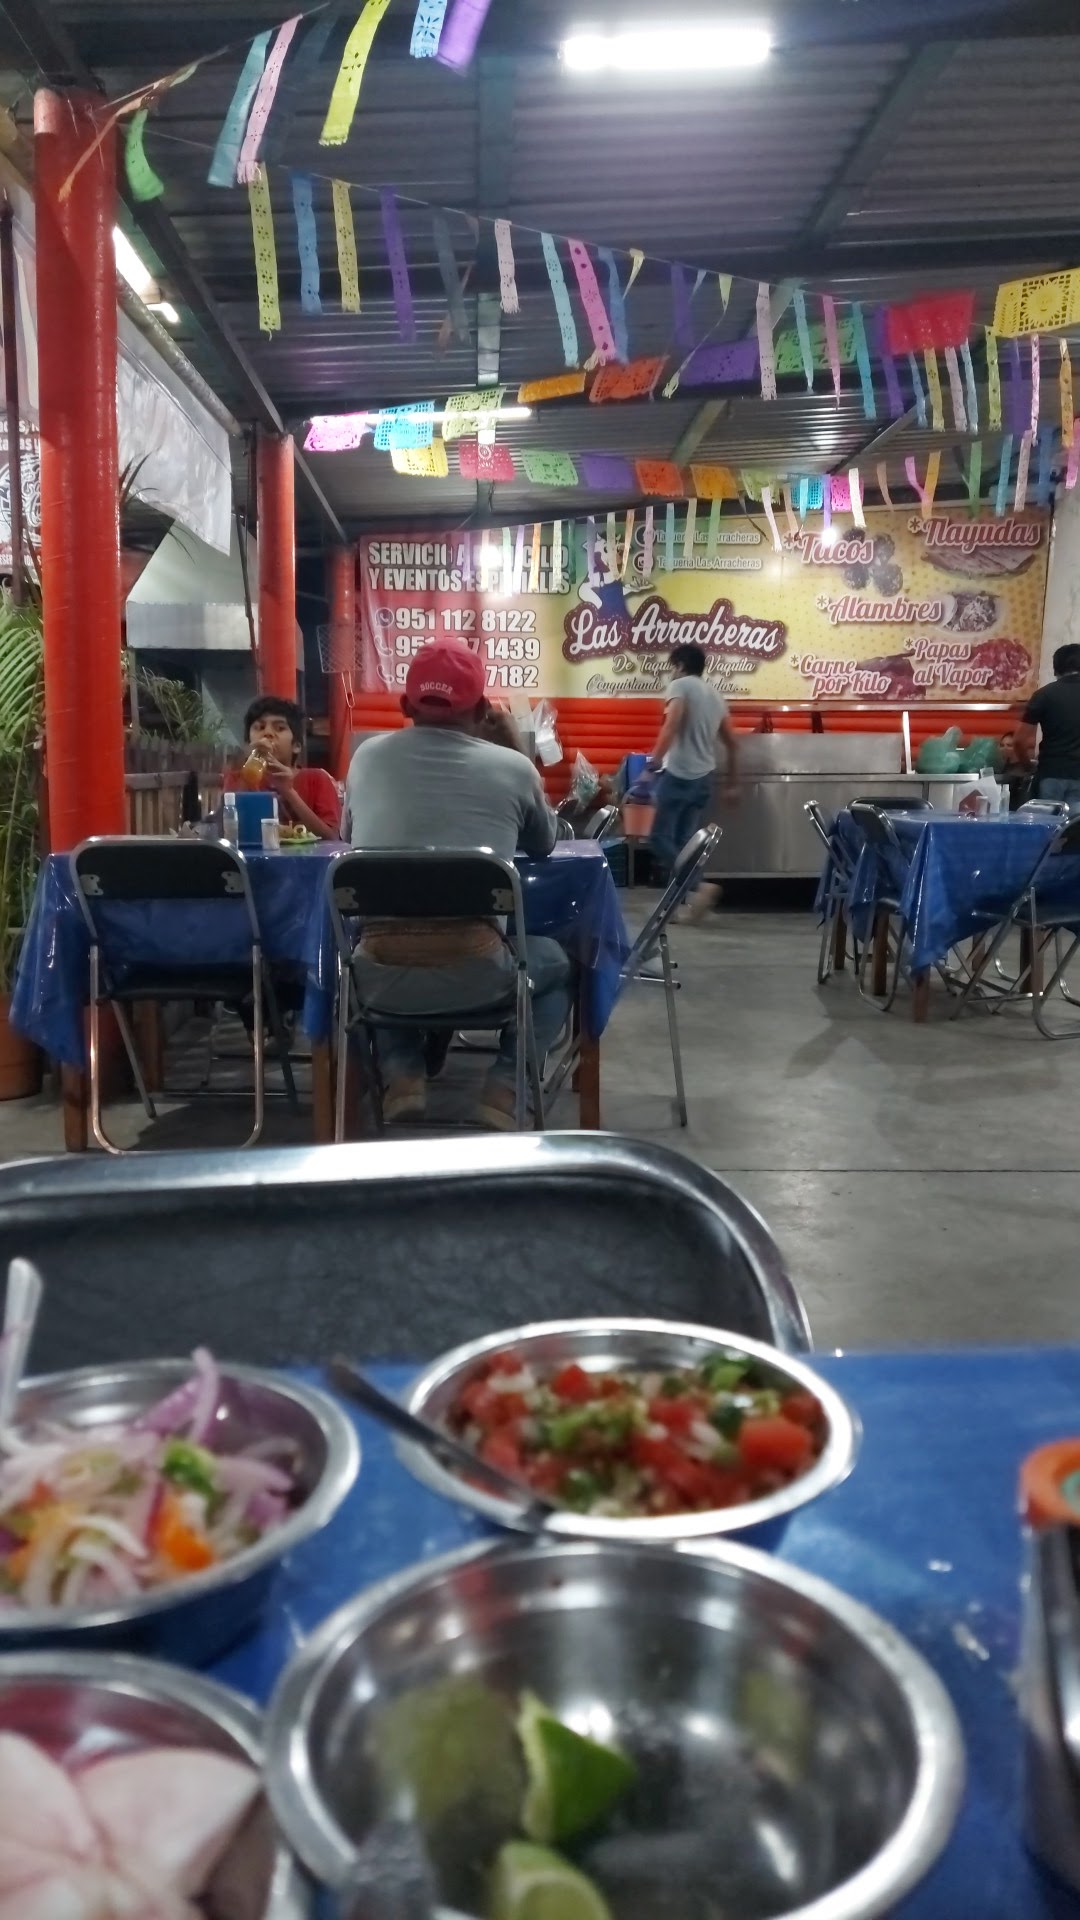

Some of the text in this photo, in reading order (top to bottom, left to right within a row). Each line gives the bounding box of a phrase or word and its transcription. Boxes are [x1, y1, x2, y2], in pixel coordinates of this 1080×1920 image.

[714, 531, 760, 542] rracheras
[369, 568, 380, 590] Y
[384, 568, 462, 592] EVENTOS
[396, 608, 536, 632] 951 112 8122
[828, 595, 940, 622] Alambres
[571, 603, 779, 654] Las Arracheras
[396, 636, 435, 657] 95
[484, 637, 540, 660] 1439
[914, 638, 970, 663] Papas
[485, 666, 539, 687] 7182
[612, 654, 634, 672] De
[705, 655, 756, 677] Vaquita
[800, 655, 857, 674] Carne
[914, 663, 992, 690] al Vapor
[420, 682, 453, 694] SOCCER
[587, 674, 663, 694] Conquistando
[812, 671, 891, 698] por Kilo
